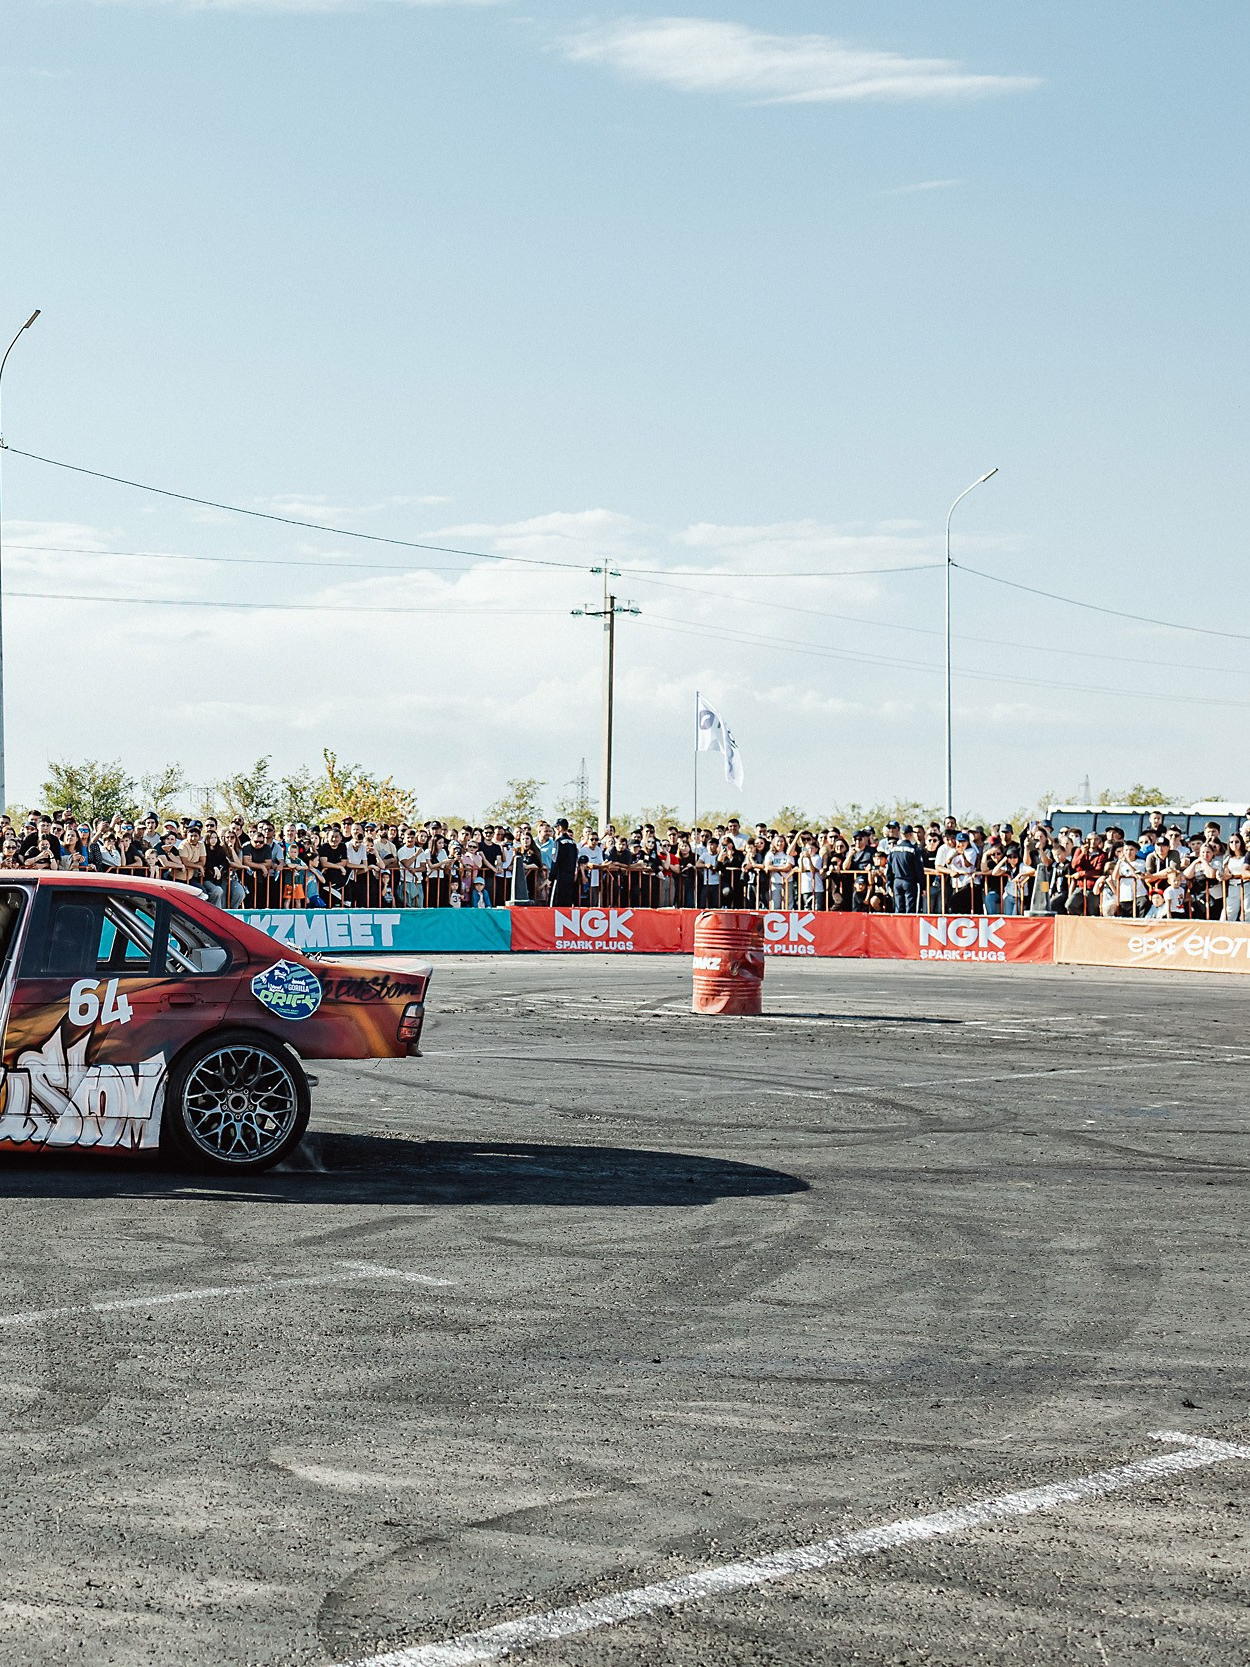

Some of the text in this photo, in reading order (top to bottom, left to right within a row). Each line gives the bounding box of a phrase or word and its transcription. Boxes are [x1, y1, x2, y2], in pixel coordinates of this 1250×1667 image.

[554, 909, 635, 939] NGK
[763, 911, 816, 943] GK
[919, 916, 1007, 949] NGK
[555, 940, 634, 951] SPARK PLUGS
[774, 943, 815, 955] PLUGS
[919, 948, 1006, 962] SPARK PLUGS
[288, 983, 310, 993] GORILLA
[68, 977, 134, 1027] 64
